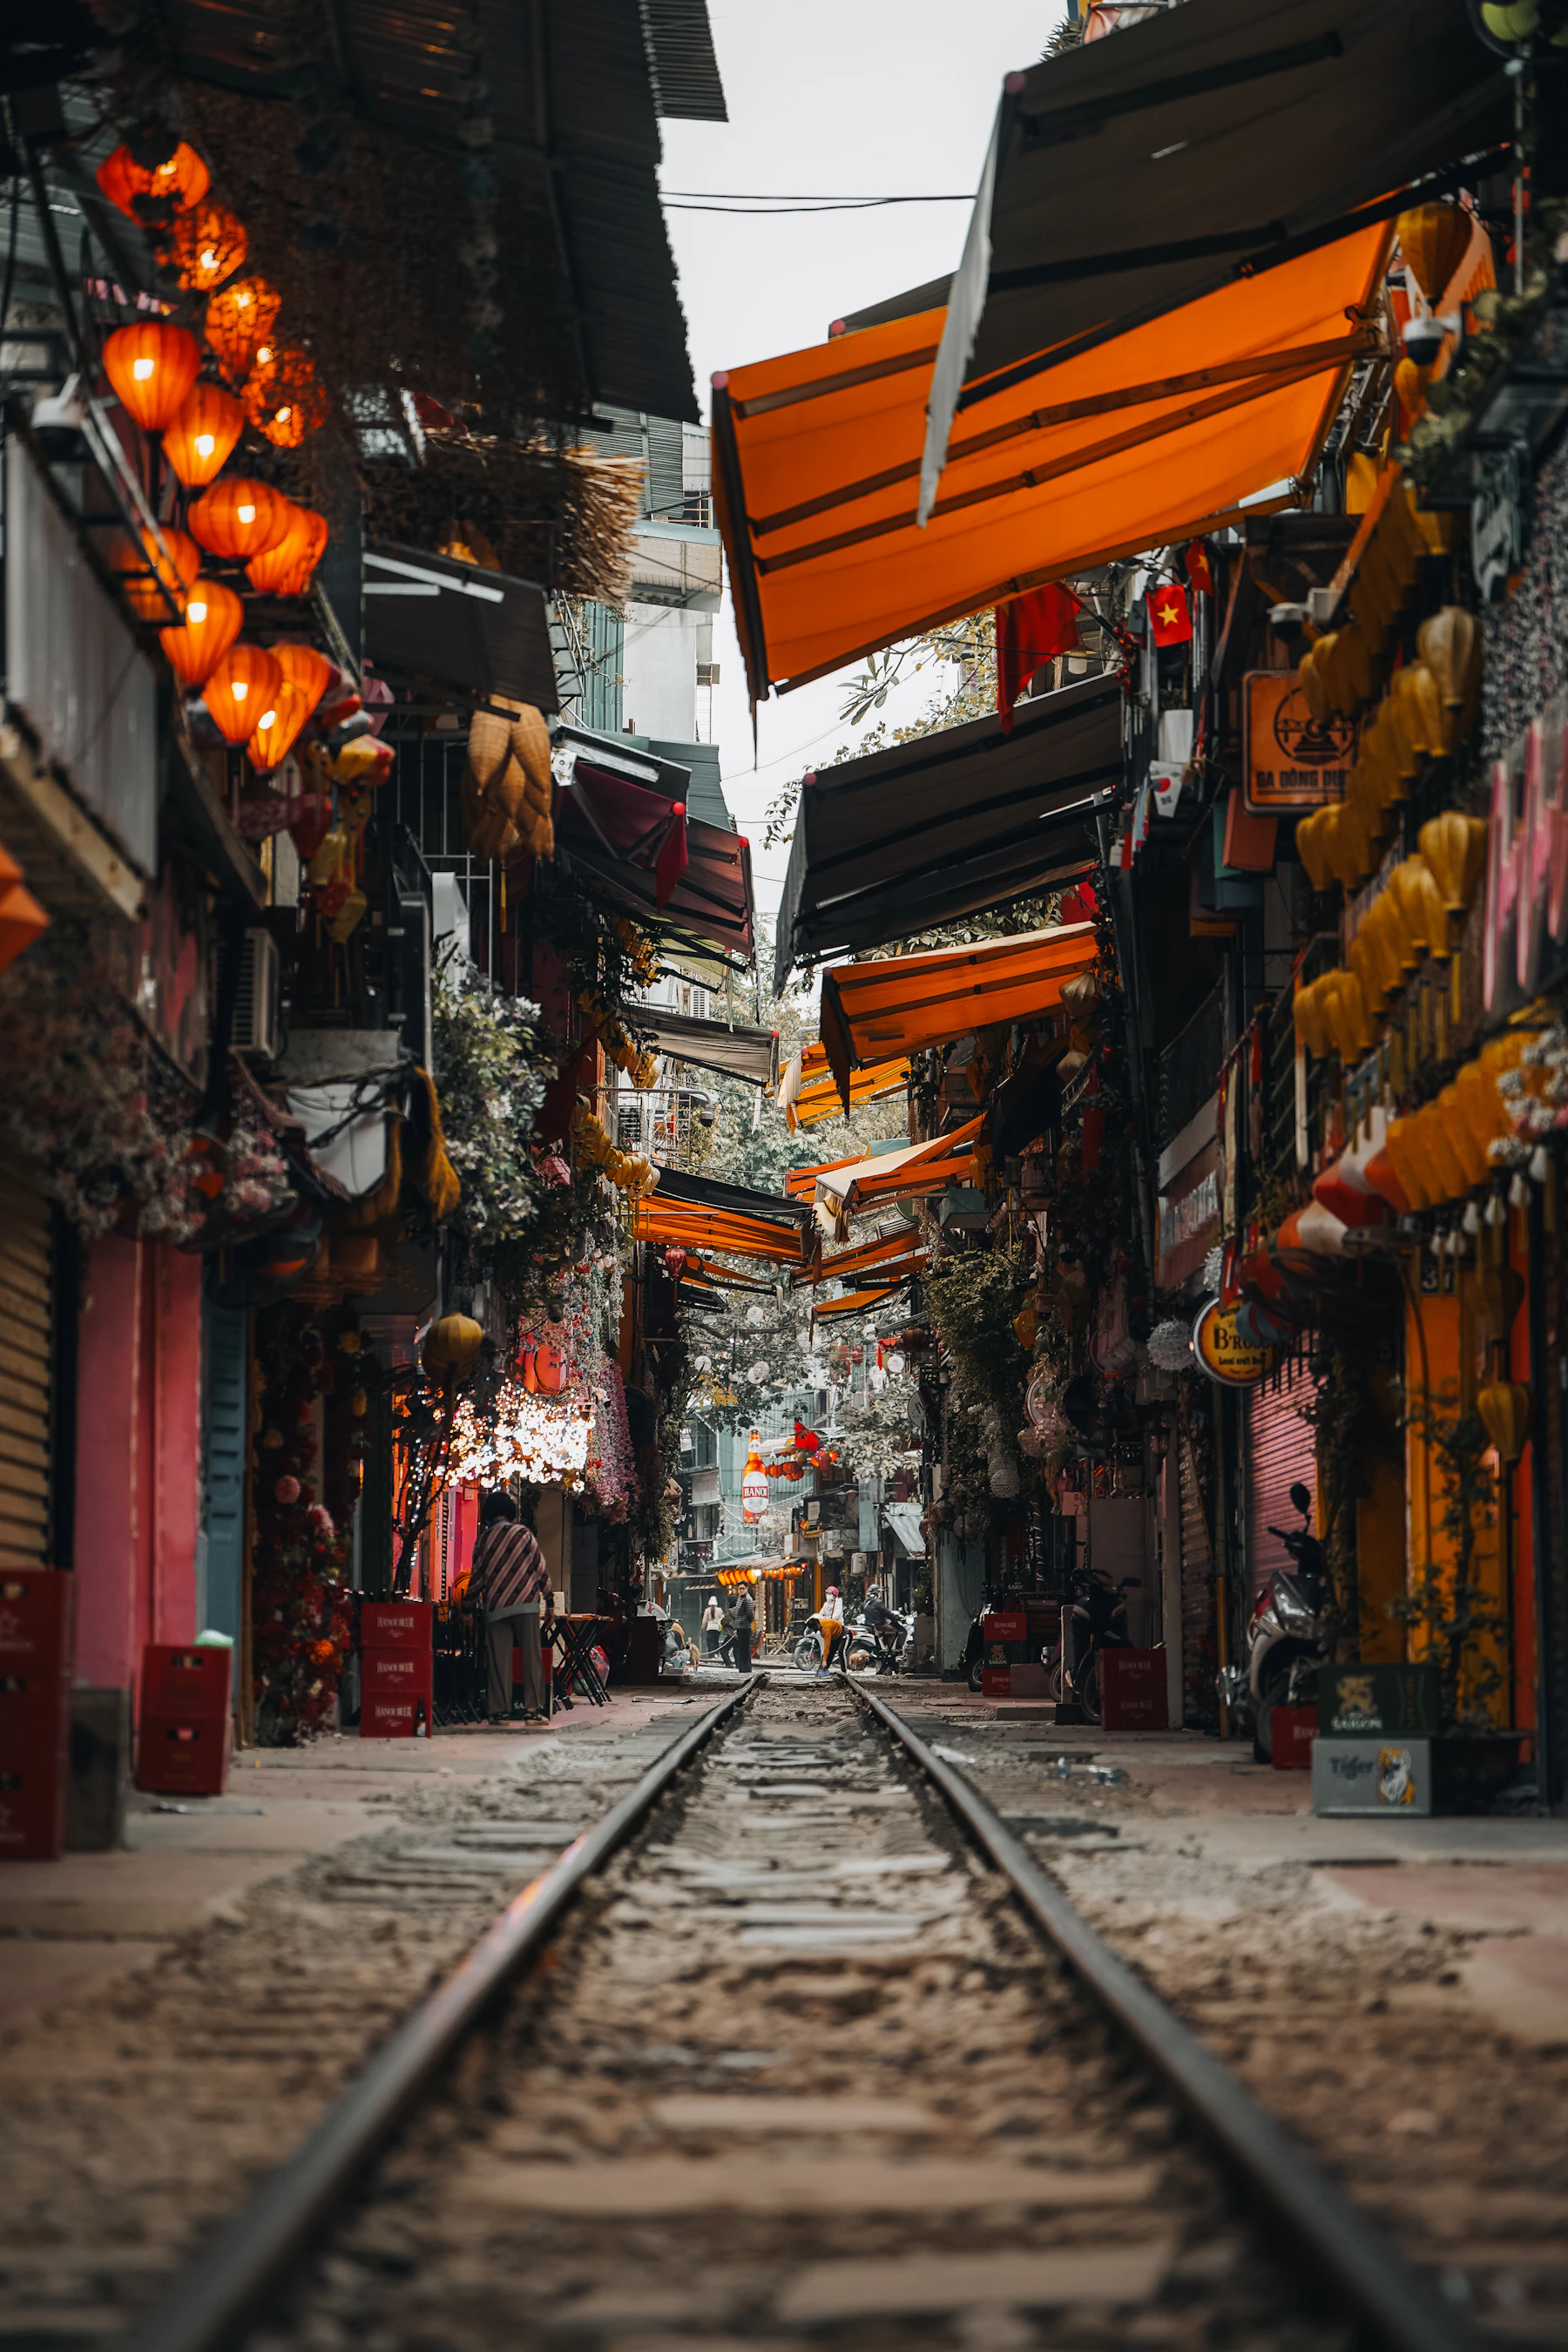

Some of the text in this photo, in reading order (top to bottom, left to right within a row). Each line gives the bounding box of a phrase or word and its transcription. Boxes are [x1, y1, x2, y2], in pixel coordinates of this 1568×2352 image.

[744, 1487, 767, 1497] HANOI
[377, 1616, 414, 1629] HANOI BEER
[377, 1662, 415, 1673] HANOI BEER
[375, 1706, 411, 1718] HANOI BEER
[1331, 1716, 1383, 1732] SAIGON
[1293, 1724, 1321, 1740] HANO
[1328, 1754, 1374, 1781] Tiger
